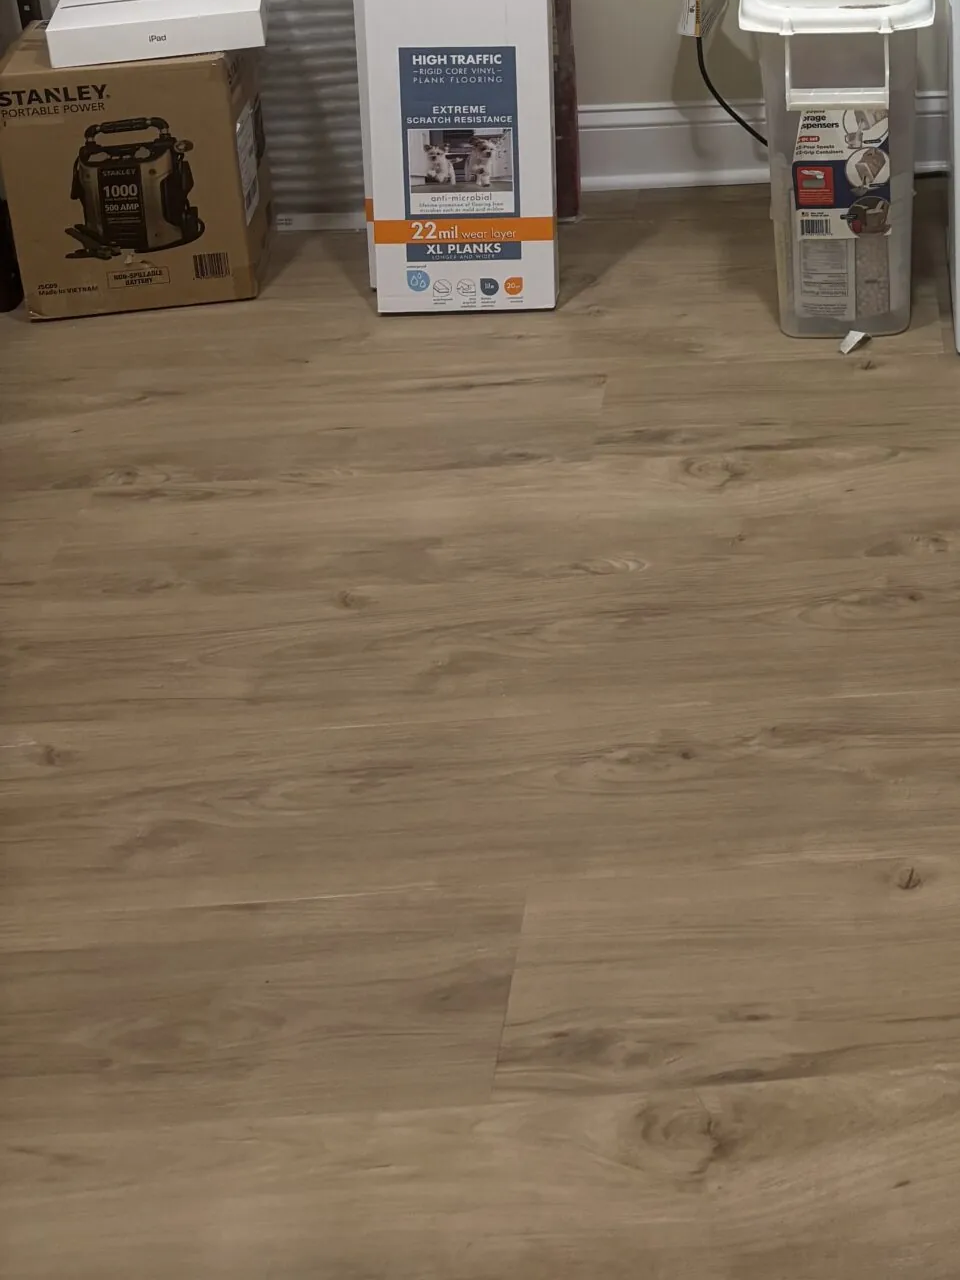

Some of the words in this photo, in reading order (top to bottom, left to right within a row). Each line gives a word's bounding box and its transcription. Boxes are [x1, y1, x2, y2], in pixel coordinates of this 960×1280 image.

[149, 34, 167, 43] iPad
[412, 54, 447, 65] HIGH
[450, 53, 502, 64] TRAFFIC
[445, 67, 467, 75] CORE
[413, 76, 445, 84] PLANK
[0, 84, 108, 107] STANLEY
[1, 105, 60, 118] PORTABLE
[63, 102, 105, 114] POWER
[432, 105, 487, 114] EXTREME
[406, 116, 451, 124] SCRATCH
[454, 115, 512, 123] RESISTANCE
[801, 122, 839, 130] spensers
[102, 168, 136, 177] STANLEY
[103, 183, 138, 198] 1000
[431, 193, 492, 202] anti-microbial
[104, 204, 119, 212] 500
[120, 203, 139, 211] AMP
[491, 228, 516, 240] layer
[426, 244, 443, 254] XL
[447, 243, 502, 254] PLANKS
